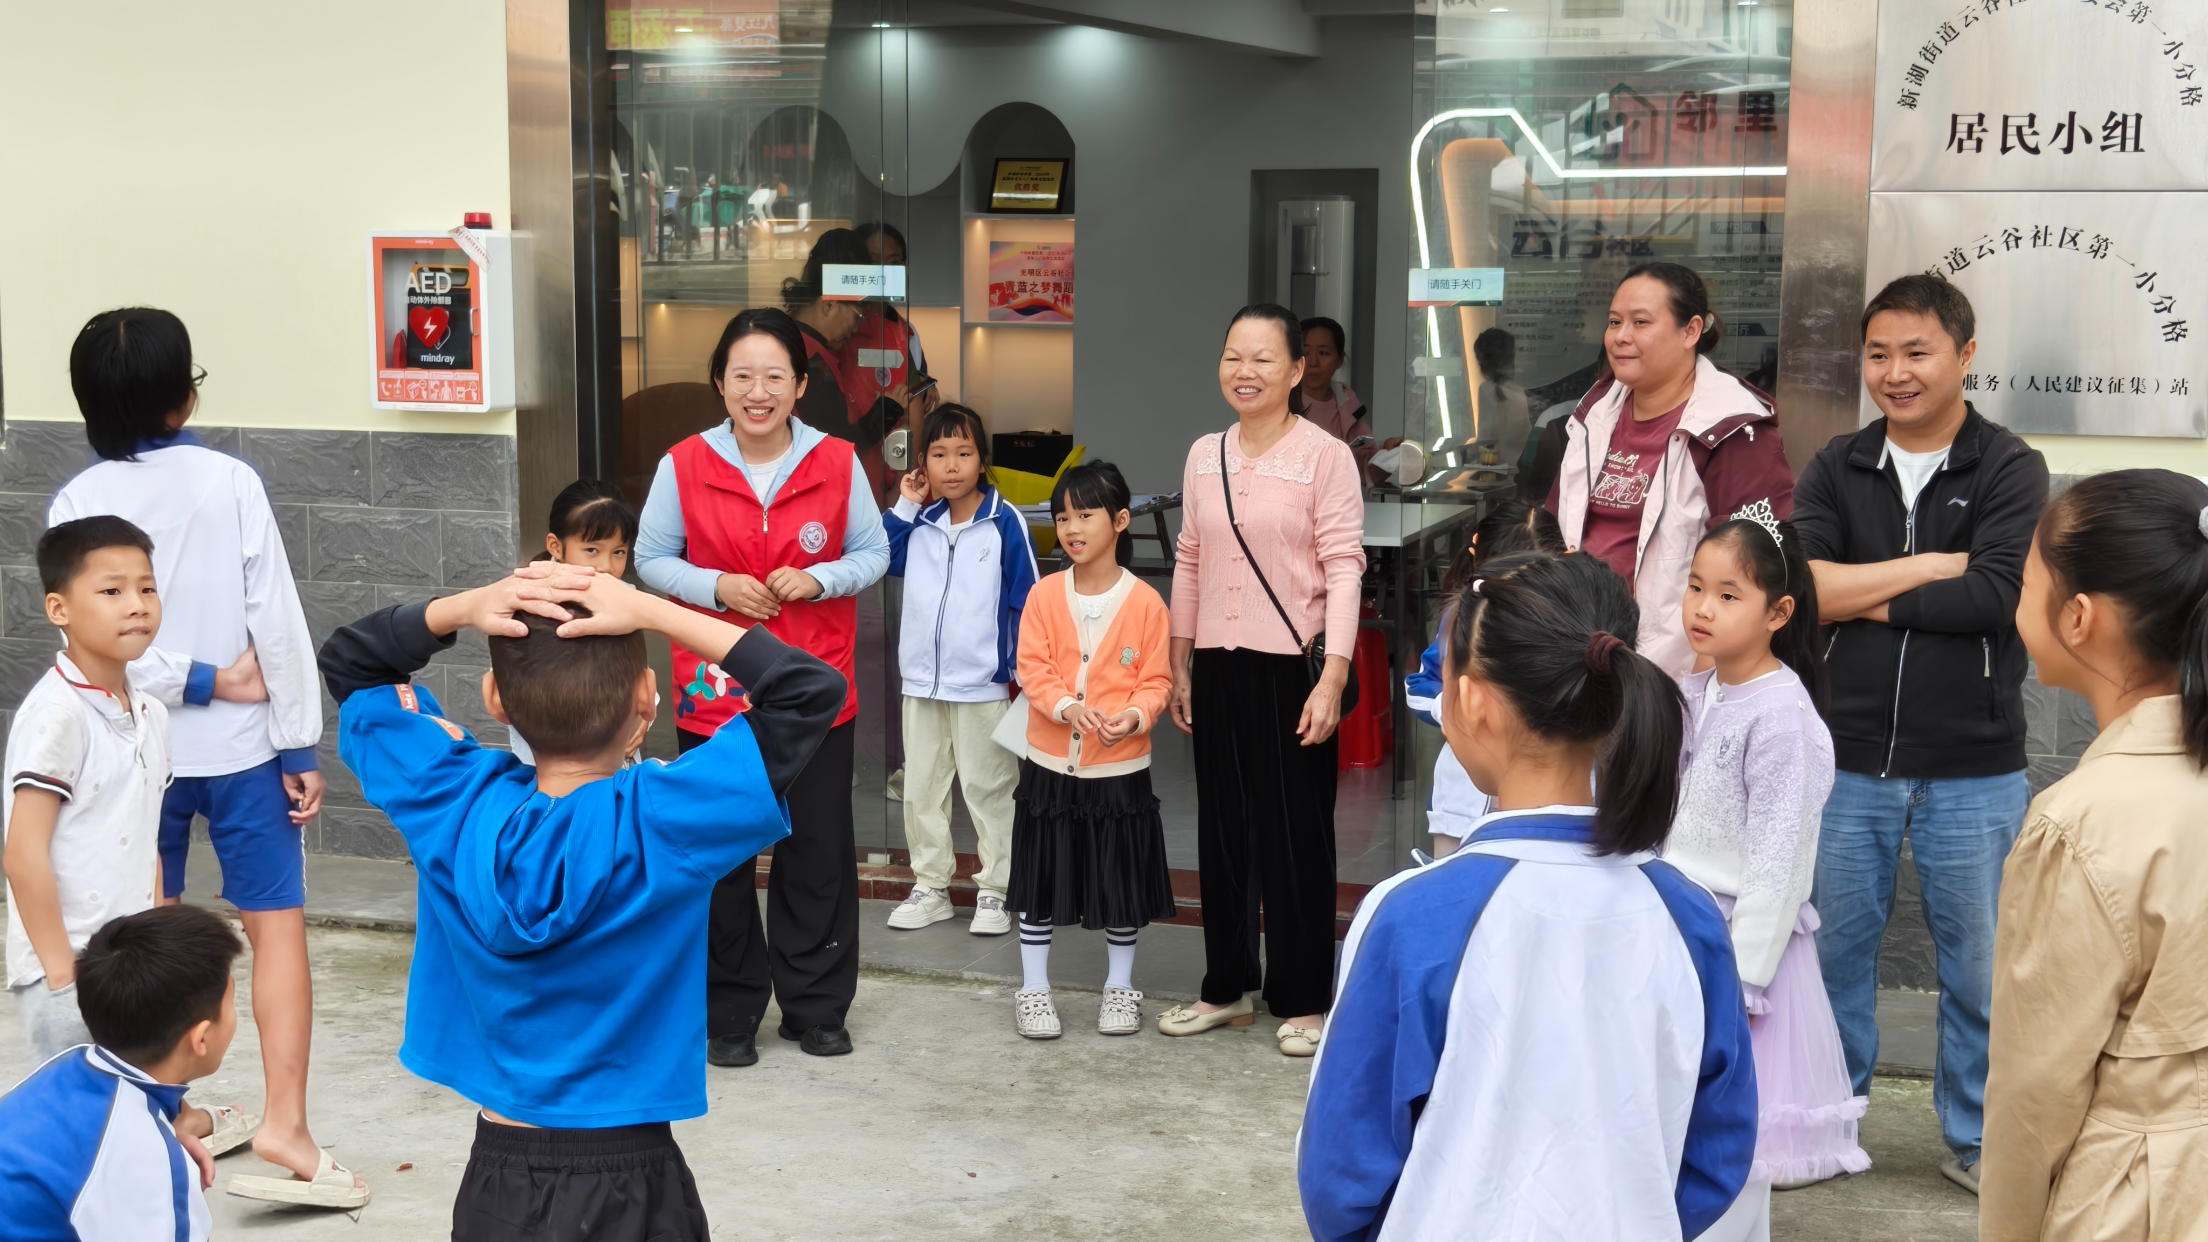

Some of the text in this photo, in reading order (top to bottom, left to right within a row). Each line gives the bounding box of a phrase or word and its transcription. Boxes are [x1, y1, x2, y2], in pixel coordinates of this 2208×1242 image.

[1676, 91, 1776, 132] 邻里
[1945, 110, 2146, 155] 居民小组
[405, 271, 452, 294] AED
[841, 275, 886, 285] 请随手关门
[1430, 279, 1481, 289] 请随手关门
[421, 353, 455, 366] mindray
